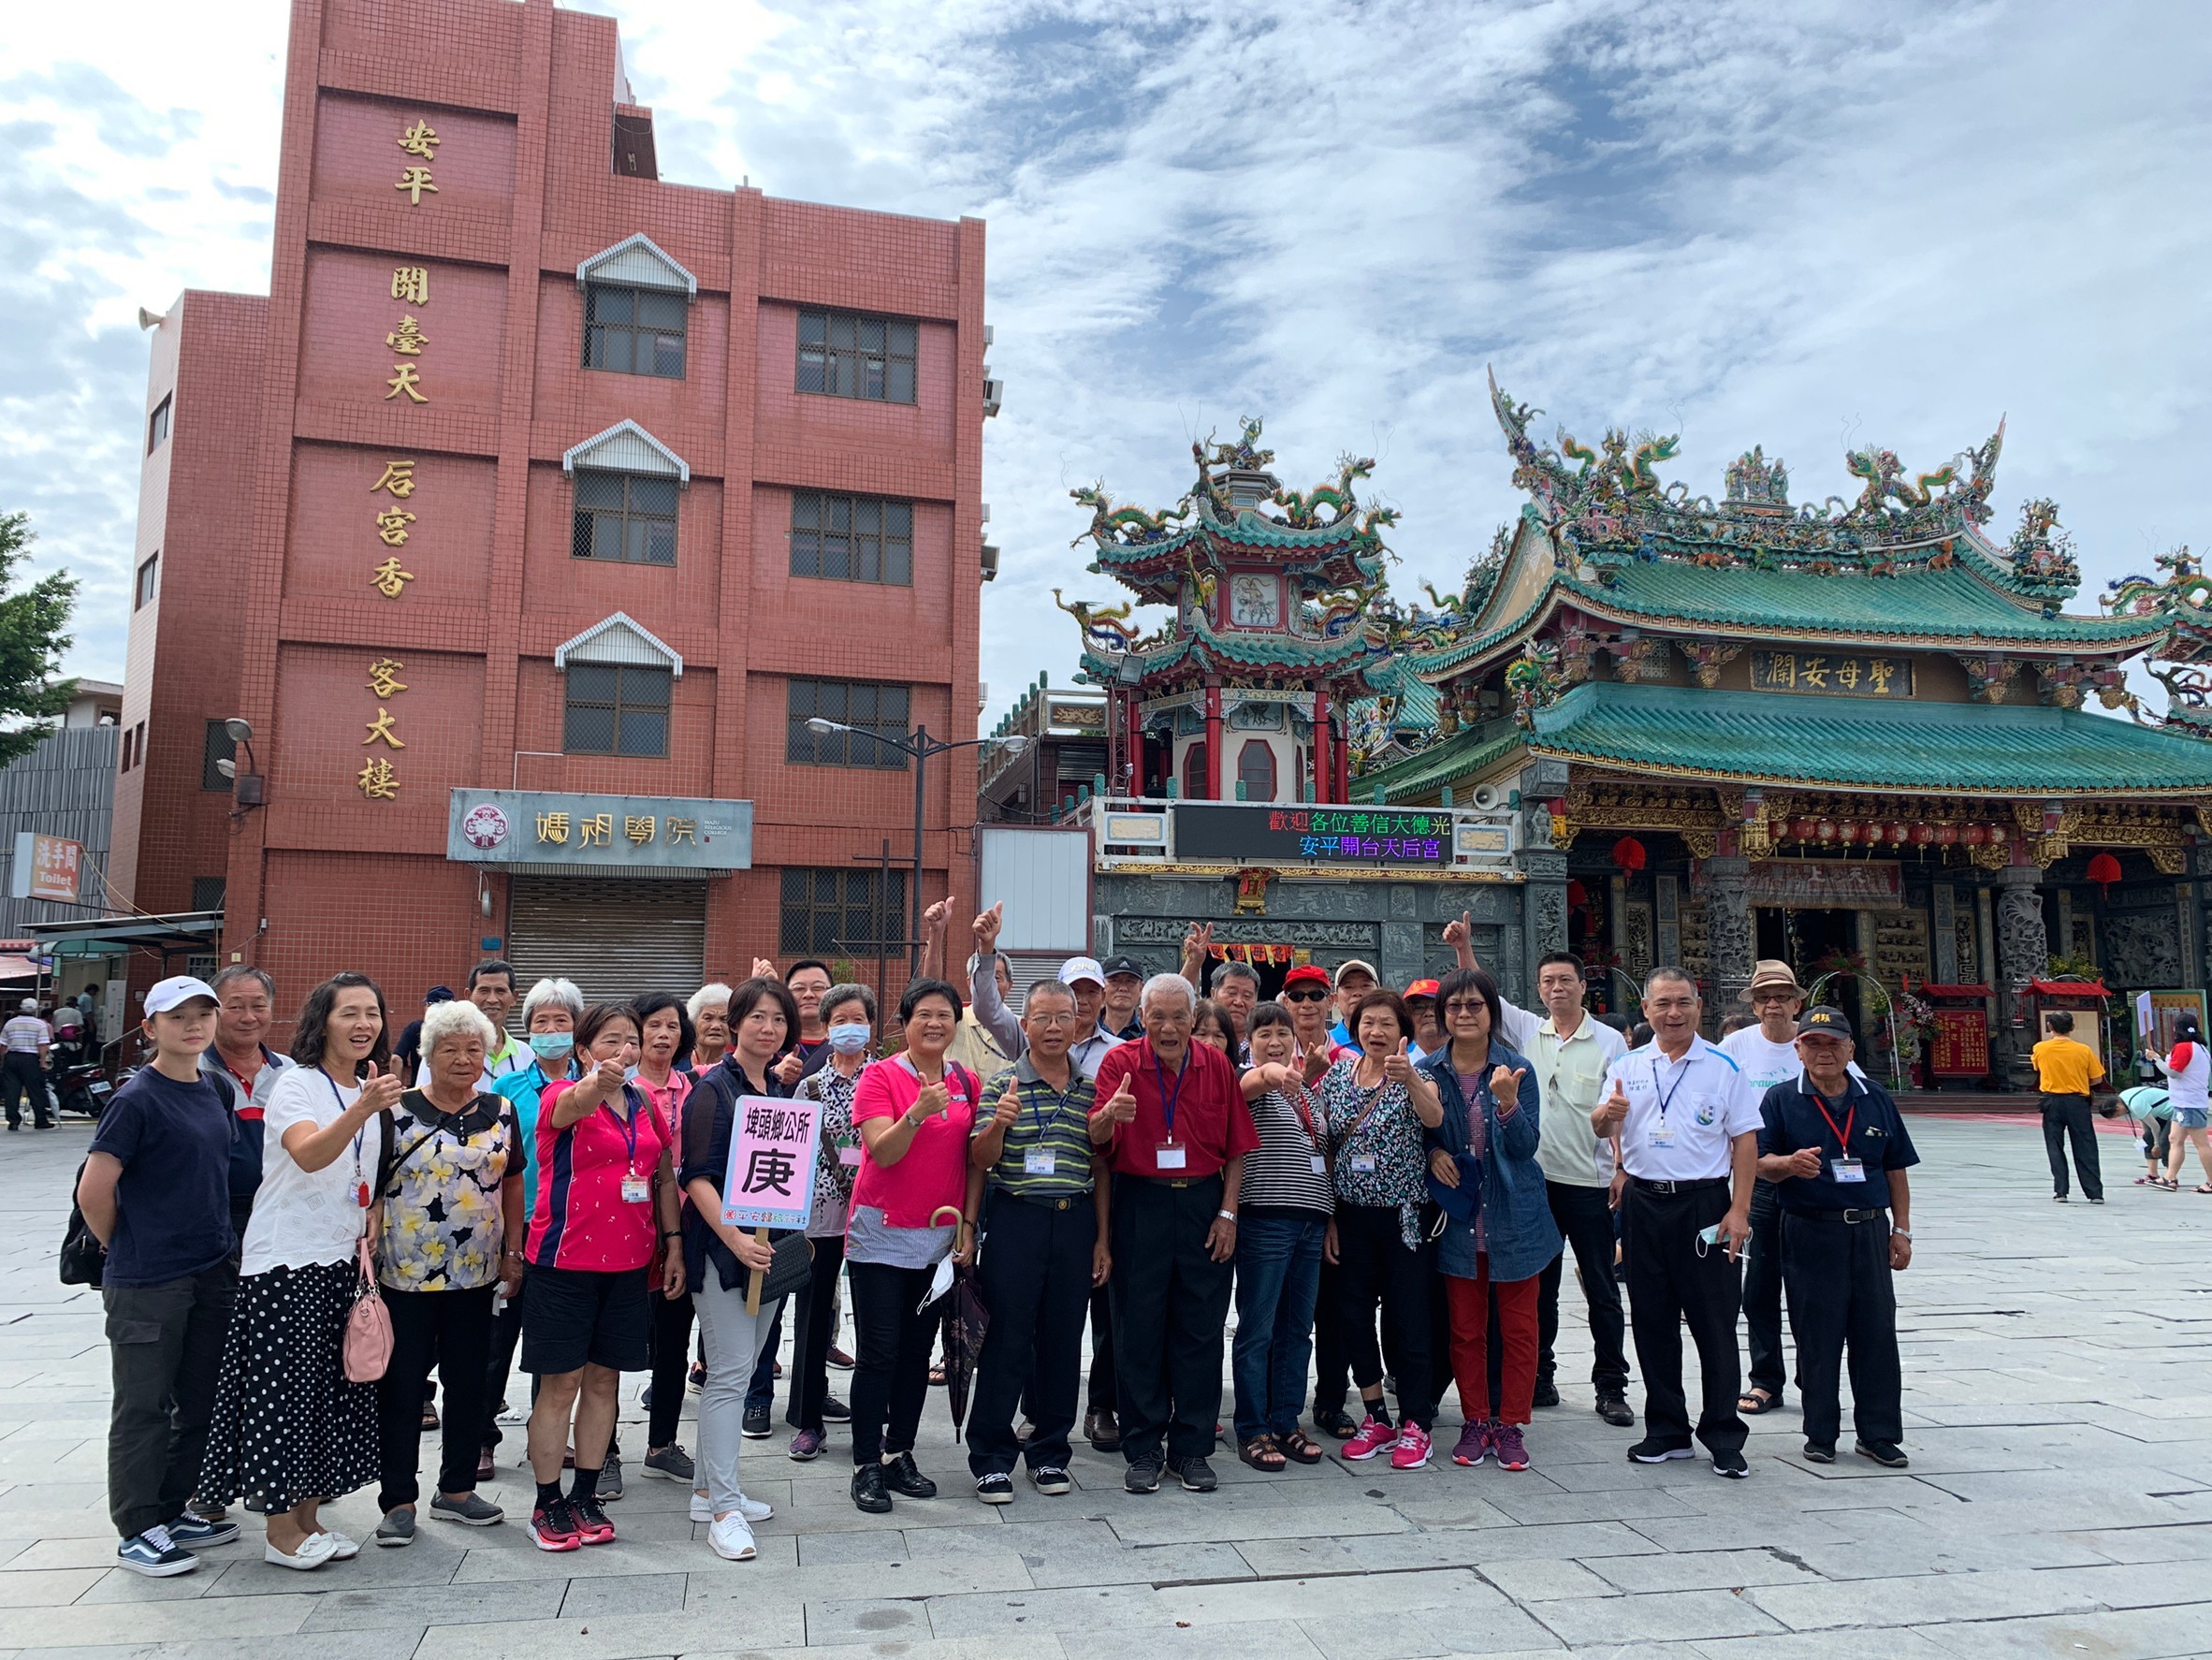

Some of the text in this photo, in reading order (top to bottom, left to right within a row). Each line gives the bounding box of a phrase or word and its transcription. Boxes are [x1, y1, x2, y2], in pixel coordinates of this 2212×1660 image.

[395, 119, 441, 206] 安平
[385, 266, 429, 403] 開臺天
[369, 459, 416, 599] 后宮香
[357, 658, 408, 800] 客大樓
[535, 811, 698, 852] 媽祖學院
[1268, 810, 1451, 837] 歡迎各位善信大德光
[36, 840, 78, 872] 洗手間
[1300, 836, 1441, 860] 安平開台天后宮
[39, 871, 72, 886] Toilet
[745, 1107, 811, 1143] 埤頭鄉公所
[741, 1148, 796, 1196] 庚
